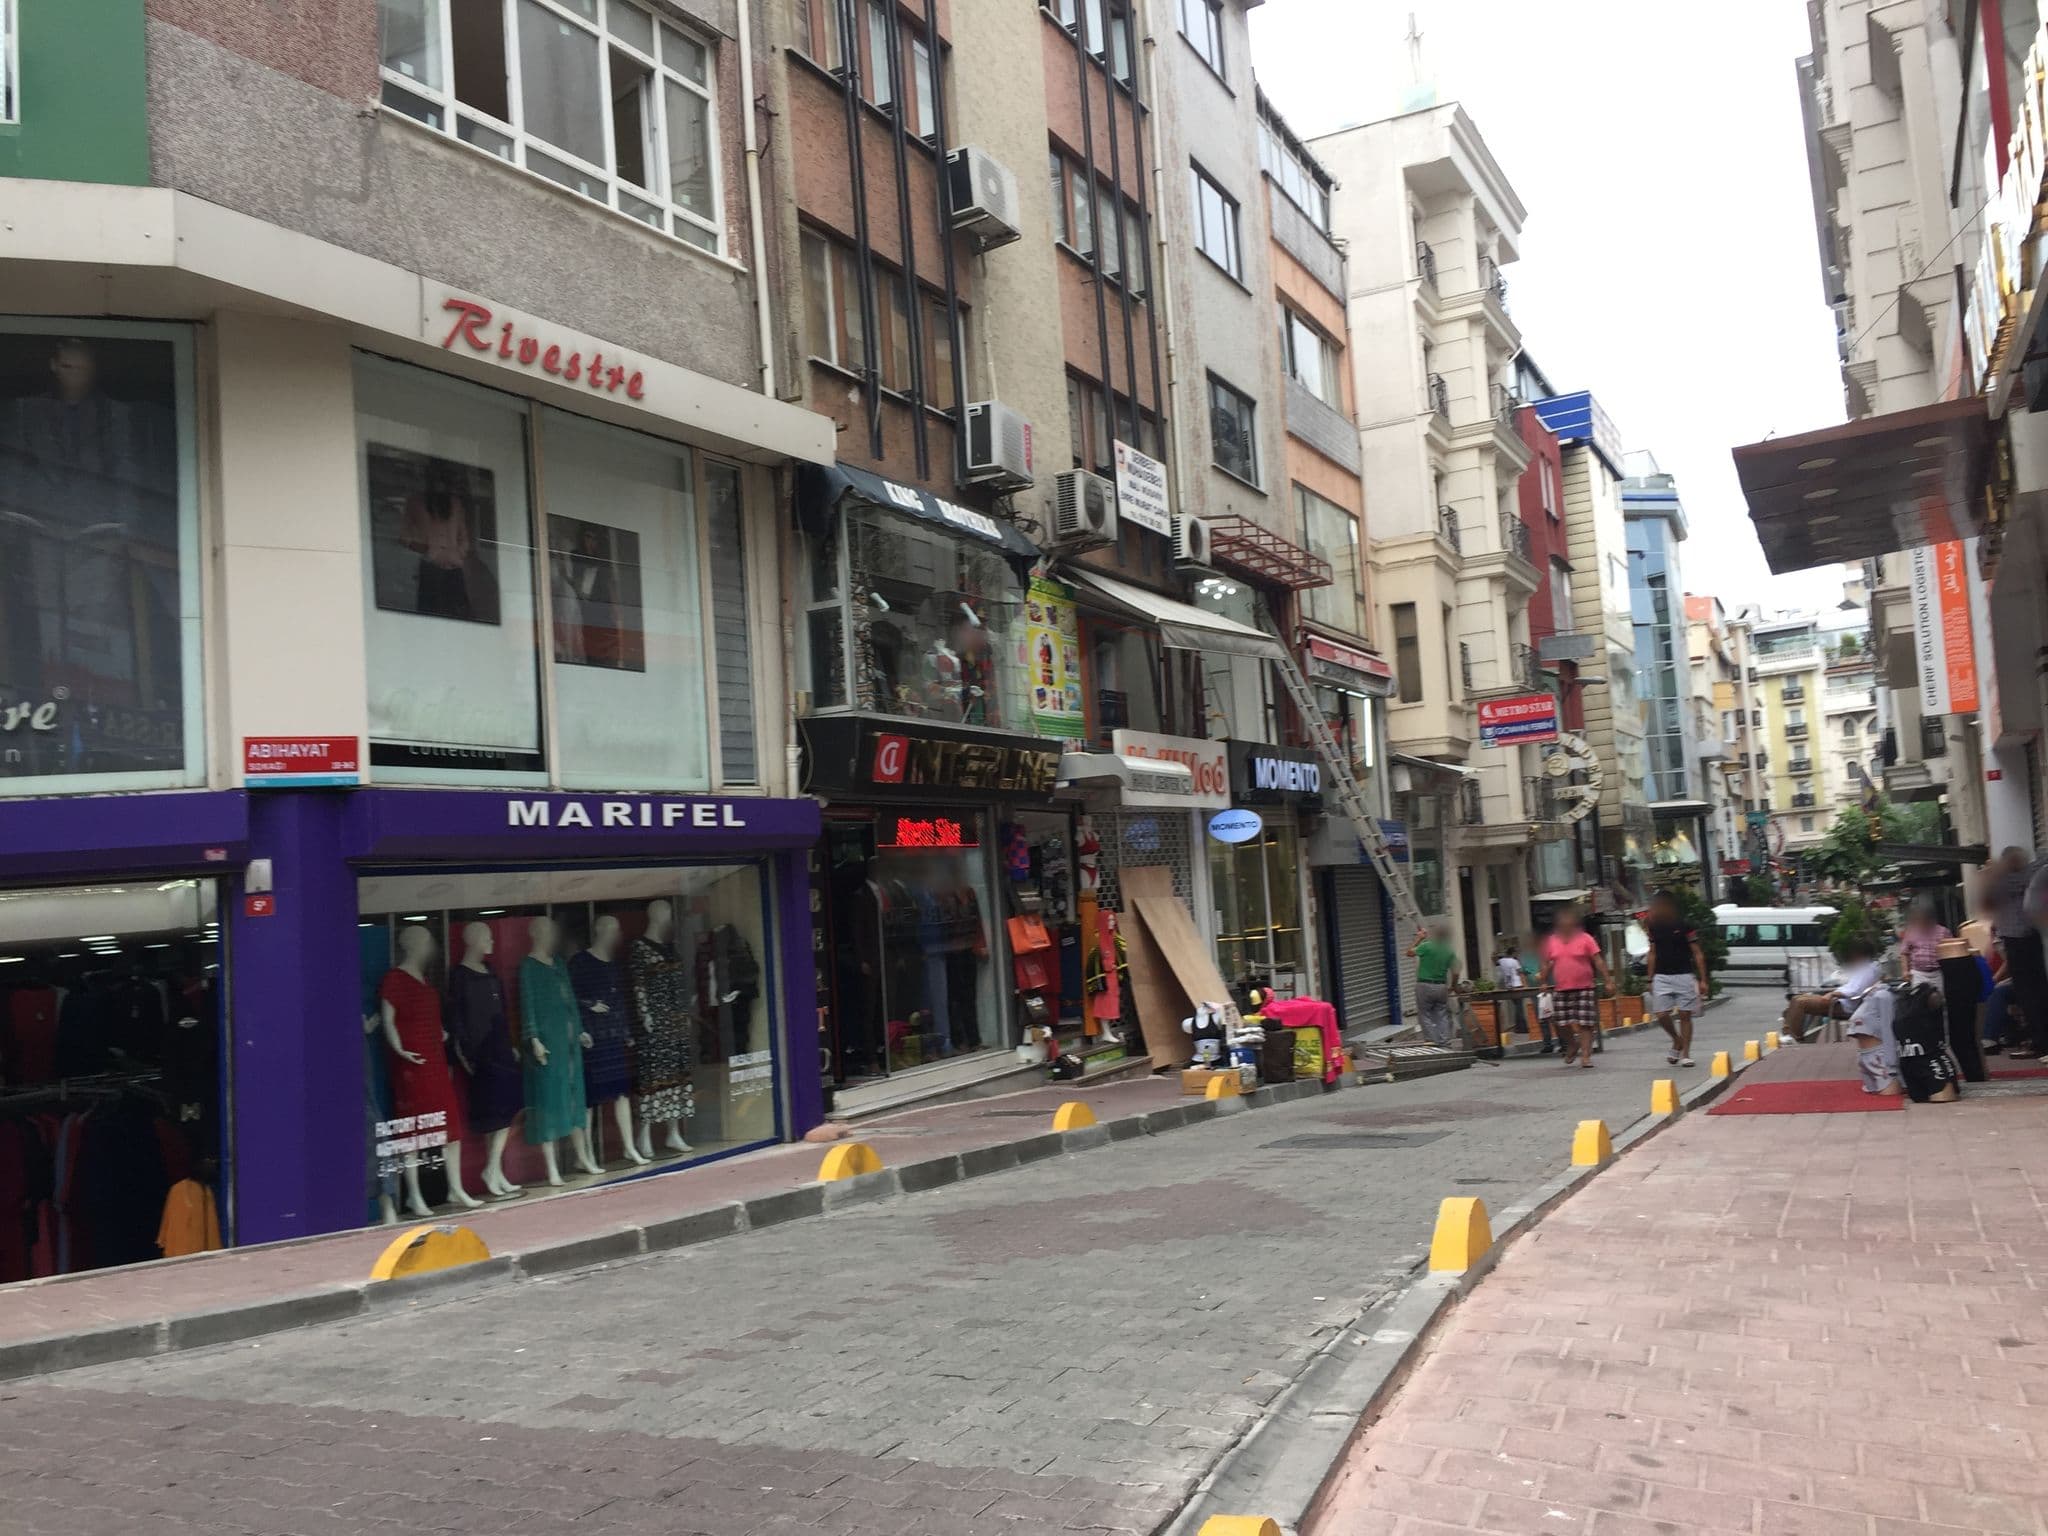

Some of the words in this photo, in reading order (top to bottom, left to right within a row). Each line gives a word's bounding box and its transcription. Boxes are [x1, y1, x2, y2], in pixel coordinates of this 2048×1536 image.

[442, 298, 645, 400] Rivestre
[1917, 602, 1934, 662] SOLUTION
[1924, 665, 1938, 707] CHERIF
[1255, 757, 1321, 793] MOMENTO
[508, 800, 747, 828] MARIFEL
[1210, 819, 1259, 832] MOMENTO
